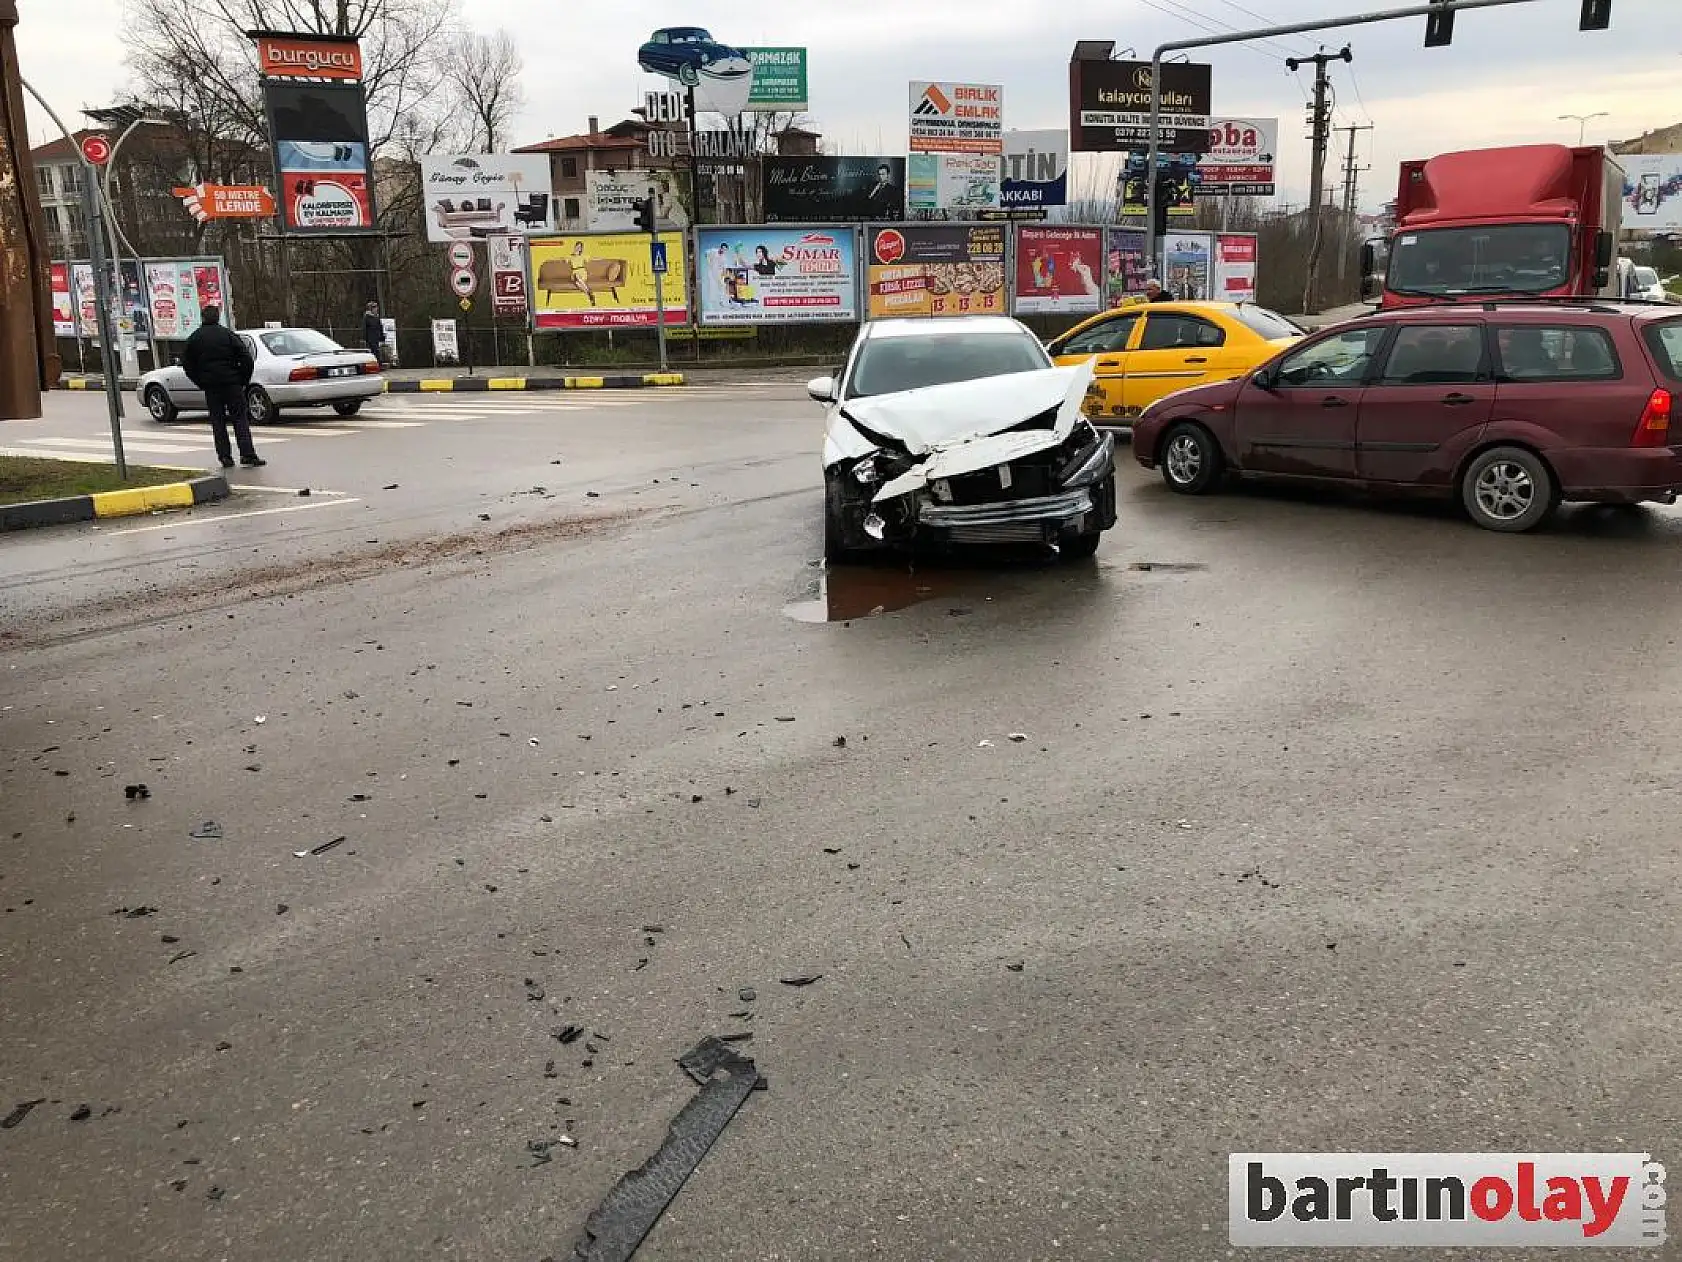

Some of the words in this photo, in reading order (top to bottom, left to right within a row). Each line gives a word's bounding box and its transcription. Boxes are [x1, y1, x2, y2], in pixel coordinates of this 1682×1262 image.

[267, 42, 355, 70] burgucu
[645, 90, 690, 122] DEDE
[1097, 87, 1192, 107] kalaycıoulları
[954, 105, 999, 118] EMLAK
[647, 130, 676, 157] OTO
[228, 190, 261, 200] METRE
